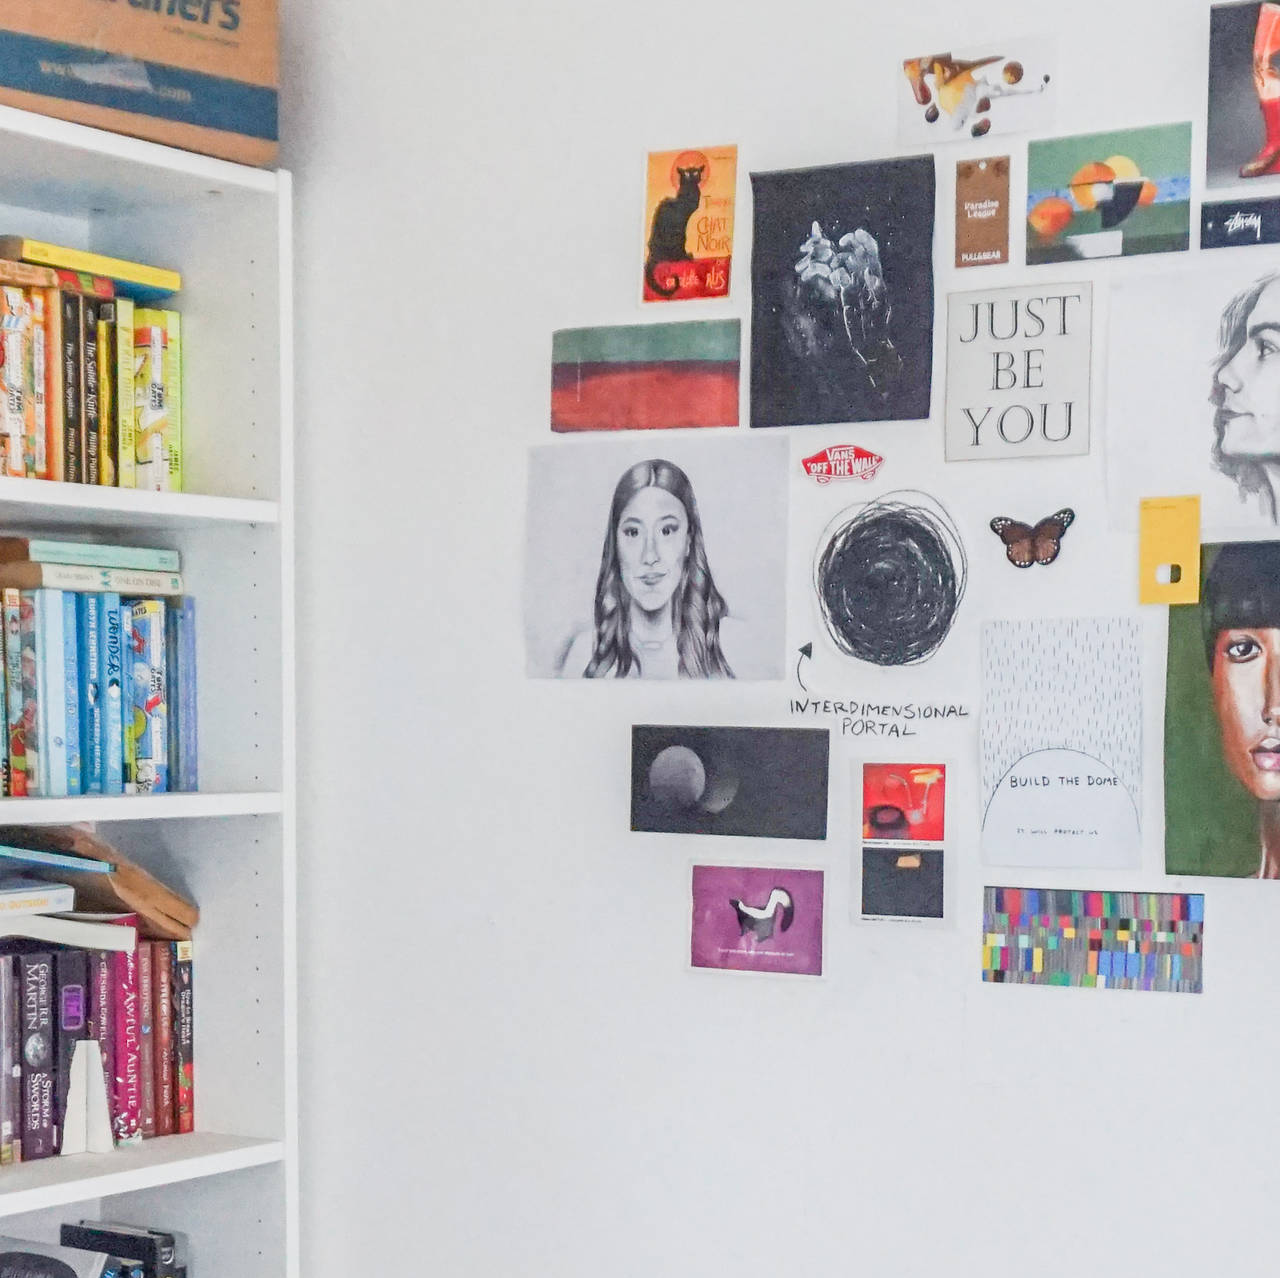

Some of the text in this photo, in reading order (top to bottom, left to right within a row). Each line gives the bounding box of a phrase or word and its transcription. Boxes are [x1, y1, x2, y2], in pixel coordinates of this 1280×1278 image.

[960, 295, 1081, 343] JUST
[65, 343, 74, 356] The
[992, 349, 1044, 390] BE
[84, 342, 98, 455] The Subtle Knife Philip
[962, 402, 1075, 446] YOU
[826, 446, 855, 460] VANS
[830, 460, 851, 476] THE
[106, 609, 119, 676] WONDER
[790, 698, 970, 720] INTERDIMENSIONAL
[842, 717, 918, 738] PORTAL
[1010, 774, 1120, 789] BUILD THE DOME
[25, 963, 39, 1030] MARTIN
[38, 963, 49, 1005] GEORGE
[98, 961, 107, 1043] CRESSIDA COWELL
[124, 990, 138, 1110] AWFUL AUNTIE
[29, 1072, 42, 1130] SWORDS
[40, 1080, 52, 1118] STORM
